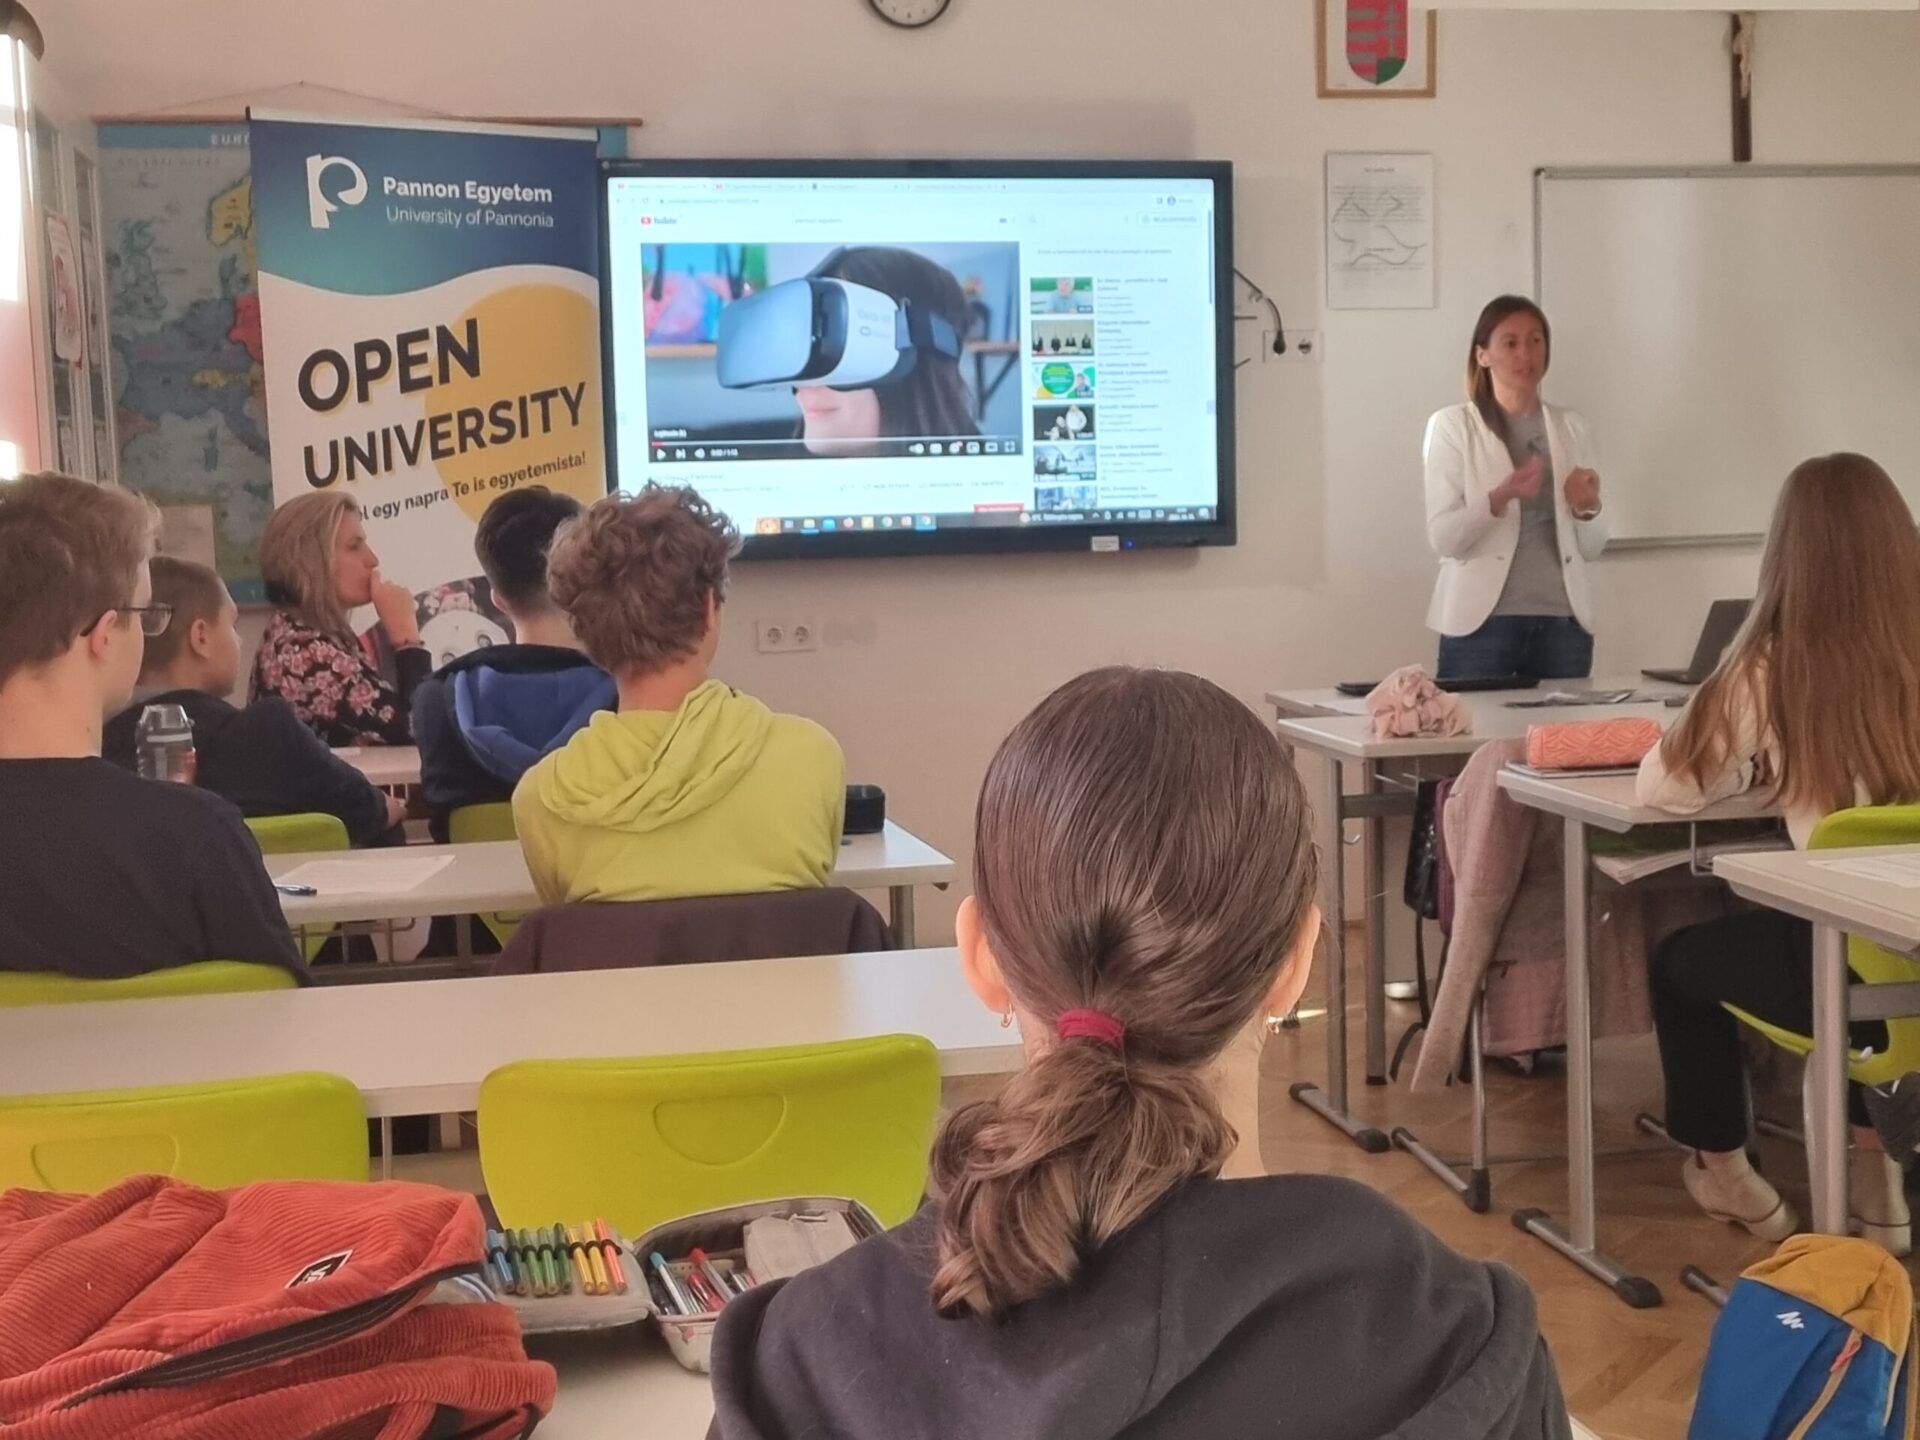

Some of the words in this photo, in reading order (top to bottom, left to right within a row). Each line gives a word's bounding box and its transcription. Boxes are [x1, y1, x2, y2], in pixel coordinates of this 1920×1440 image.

[383, 176, 460, 199] Pannon
[465, 180, 553, 205] Egyetem
[386, 206, 463, 229] University
[466, 209, 482, 225] of
[485, 210, 554, 228] Pannonia
[298, 318, 481, 413] OPEN
[303, 381, 586, 489] UNIVERSITY
[372, 499, 401, 520] egy
[405, 487, 449, 511] napra
[452, 481, 470, 498] Te
[473, 476, 485, 492] is
[489, 451, 587, 489] egyetemista!
